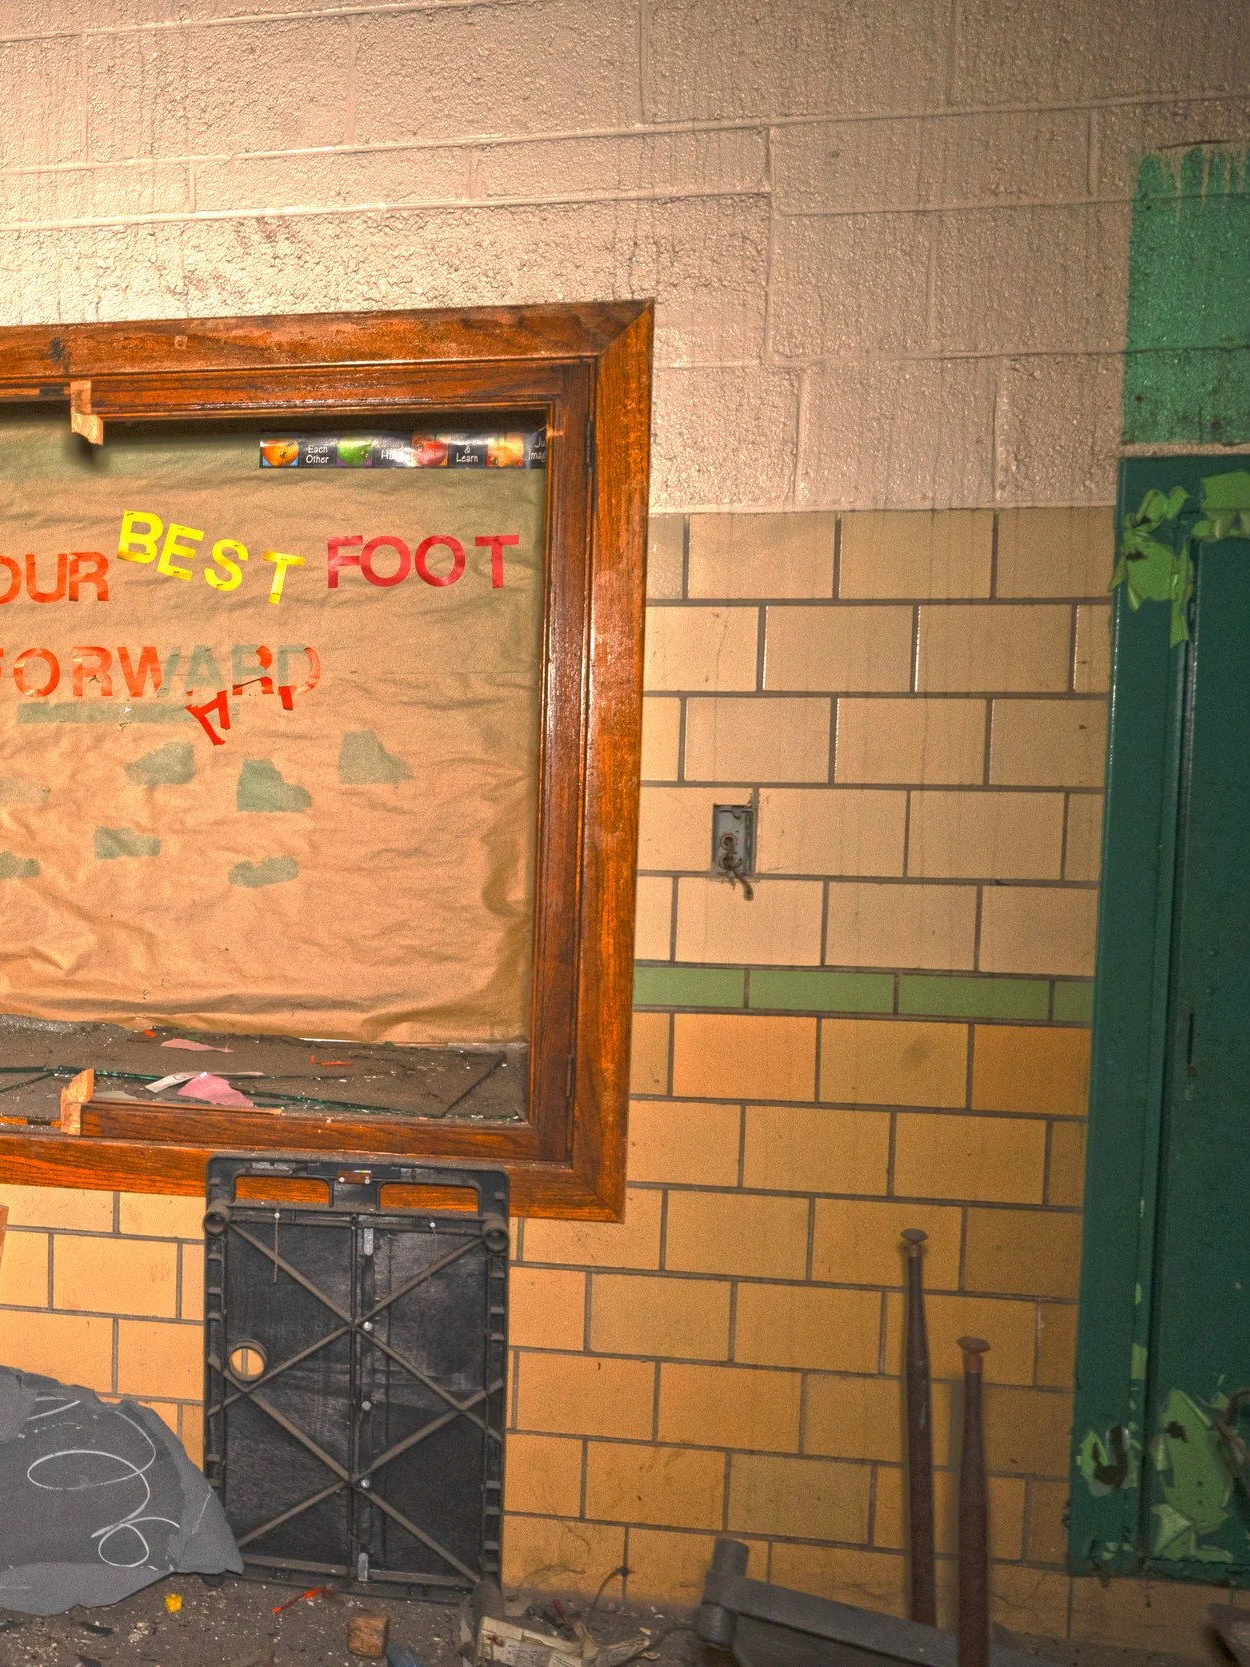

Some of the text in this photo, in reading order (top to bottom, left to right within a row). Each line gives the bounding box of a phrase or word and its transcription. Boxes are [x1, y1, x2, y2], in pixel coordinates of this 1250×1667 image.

[308, 444, 328, 453] Each
[464, 444, 471, 454] &
[305, 454, 329, 464] Other
[456, 453, 478, 463] Learn
[116, 509, 305, 605] BEST
[326, 534, 519, 589] FOOT
